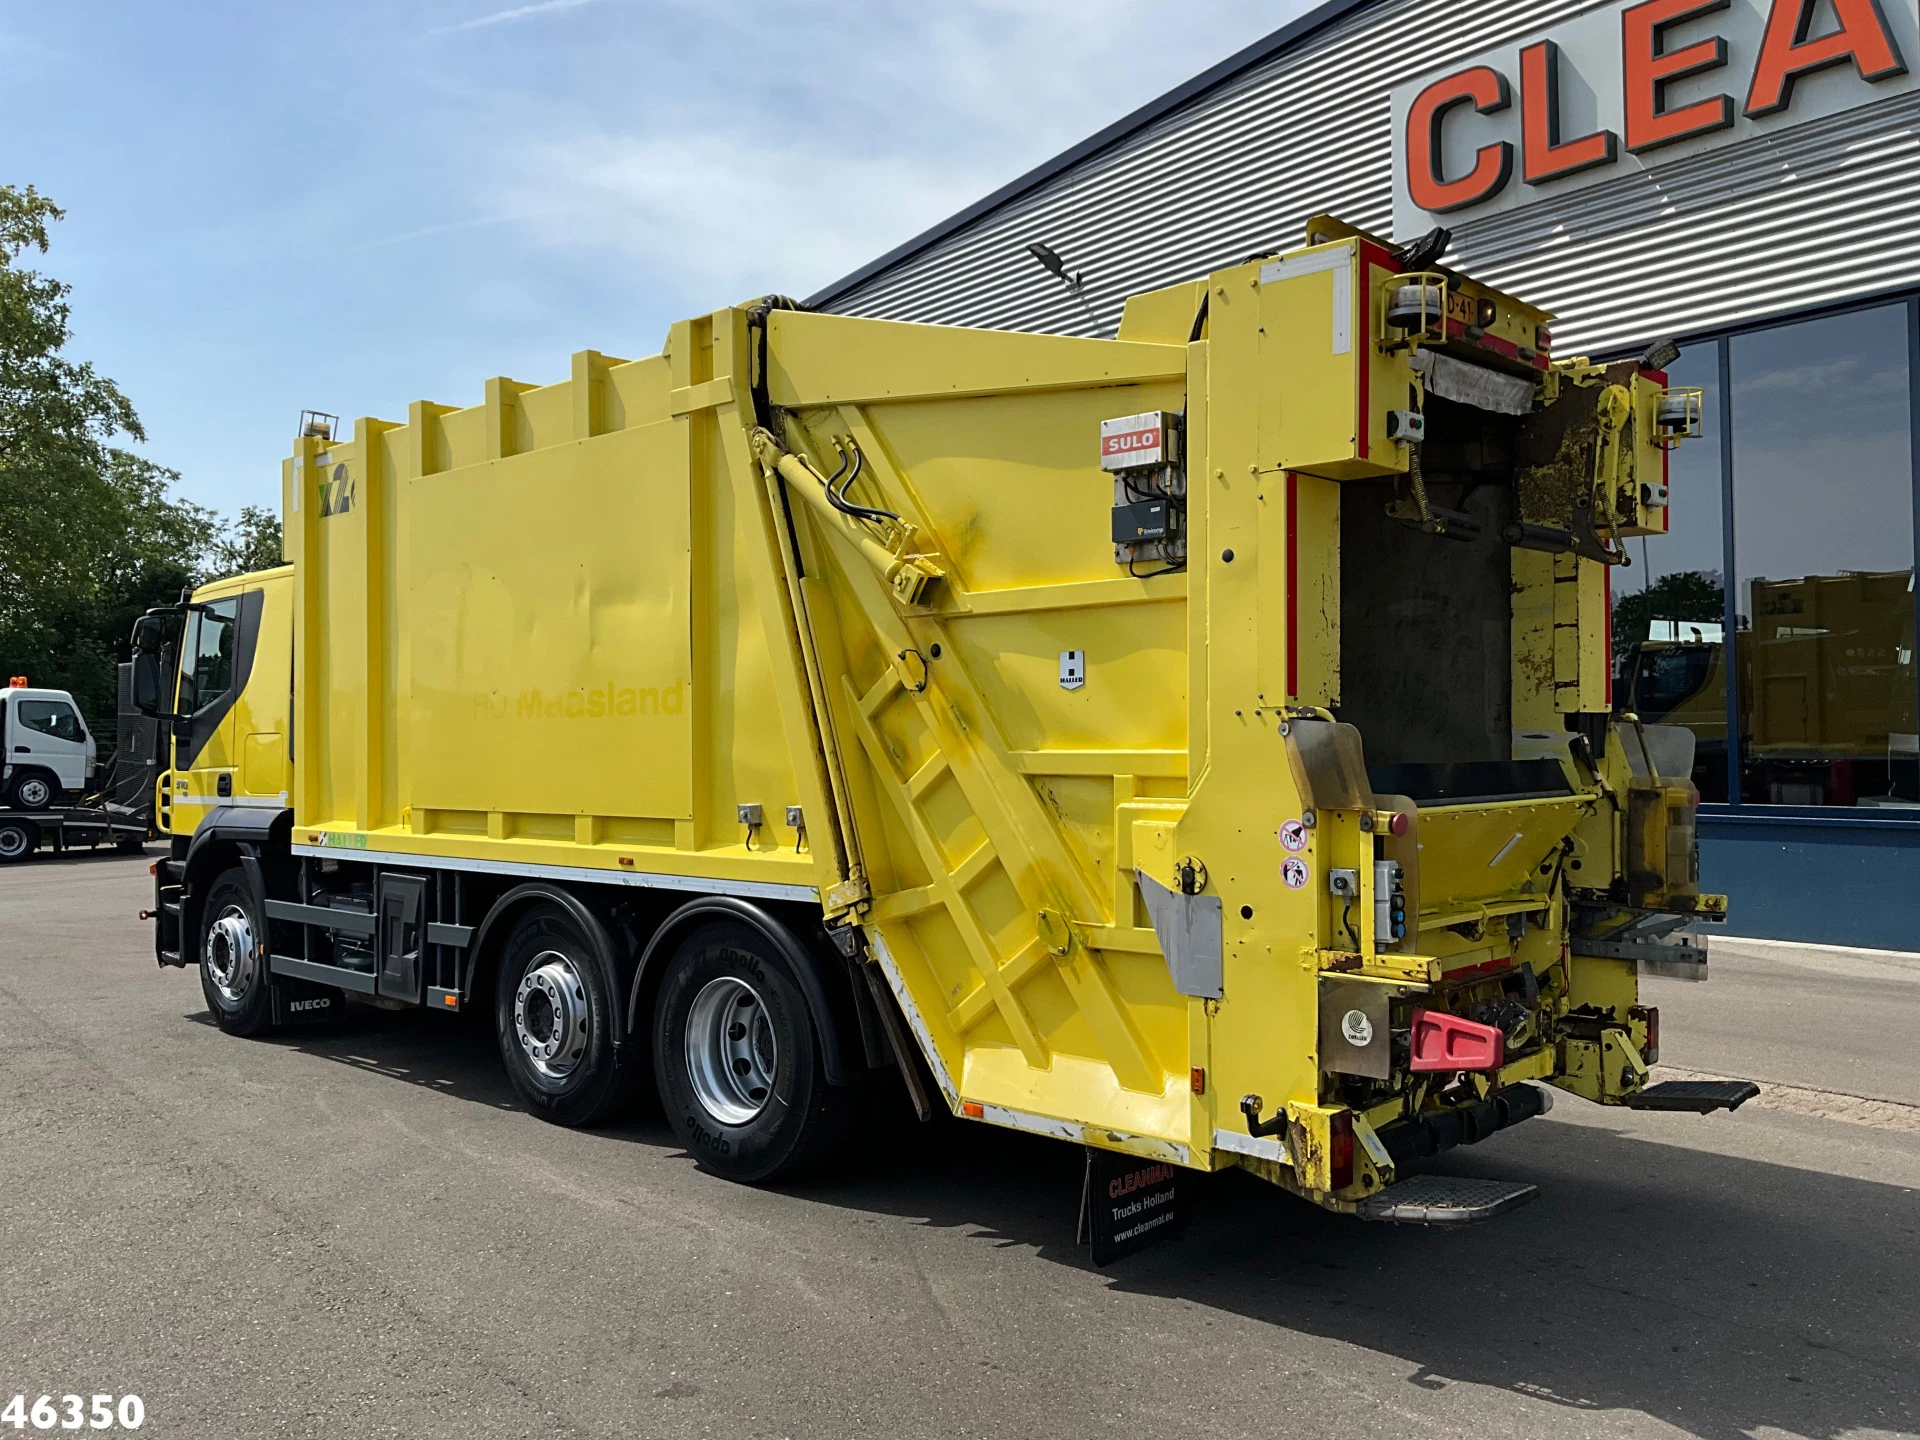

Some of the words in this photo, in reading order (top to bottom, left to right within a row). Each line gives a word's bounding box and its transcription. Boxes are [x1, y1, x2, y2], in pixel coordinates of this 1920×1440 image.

[1440, 293, 1471, 321] D-41
[1109, 432, 1154, 452] SULO
[516, 678, 684, 720] Maasland
[328, 832, 367, 848] HALLER
[719, 947, 766, 983] apollo
[290, 998, 330, 1011] IVECO
[686, 1115, 731, 1155] apollo
[1112, 1202, 1141, 1221] Trucks
[1143, 1187, 1174, 1210] Holland
[1114, 1212, 1174, 1243] www.cleanmat.eu
